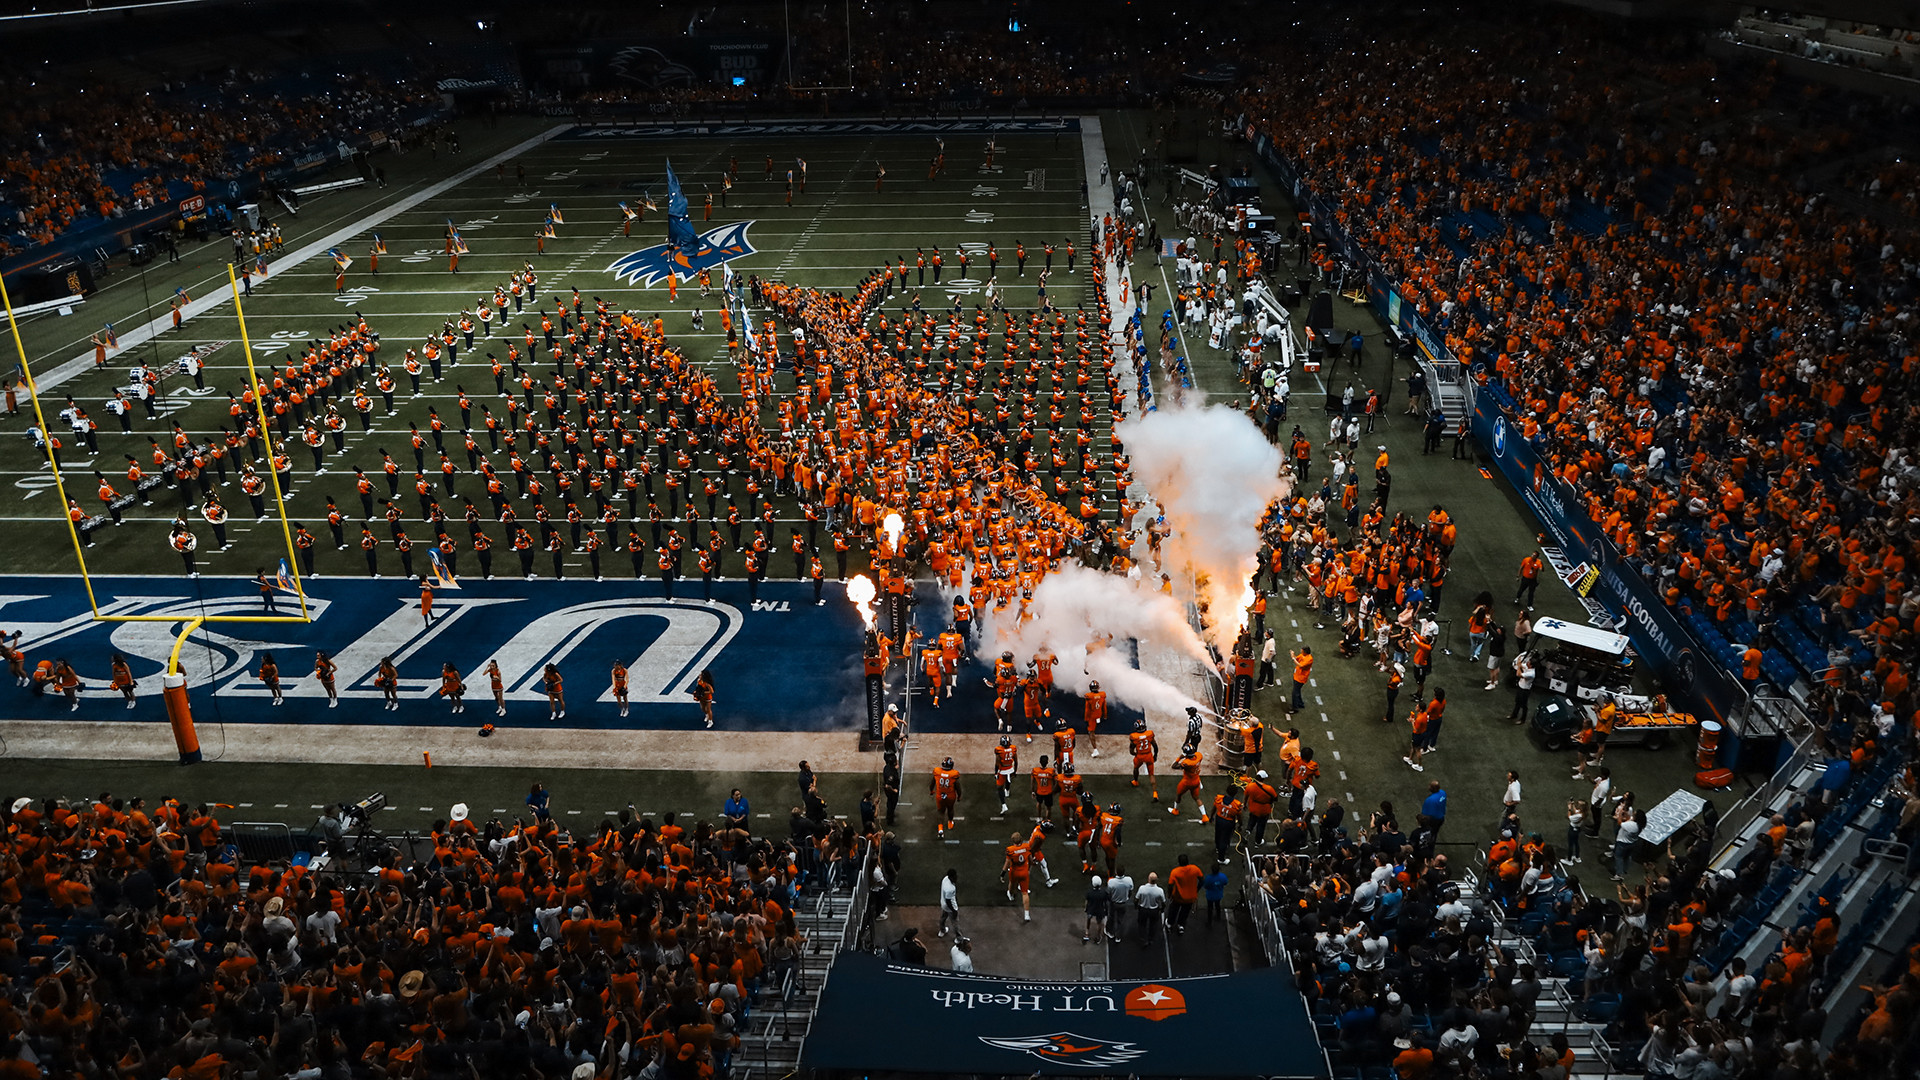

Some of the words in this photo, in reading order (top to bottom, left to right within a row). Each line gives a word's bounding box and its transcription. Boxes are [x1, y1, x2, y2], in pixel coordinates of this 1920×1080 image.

[720, 56, 758, 69] BUD
[576, 122, 1068, 137] ROADRUNNERS
[182, 198, 203, 211] H-E-B
[752, 600, 791, 612] TM
[891, 596, 900, 634] ATHLETICS
[1606, 570, 1628, 603] UTSA
[1628, 596, 1674, 660] FOOTBALL
[946, 641, 954, 650] 95
[872, 680, 880, 736] ROADRUNNERS
[1139, 740, 1149, 750] 23
[940, 778, 950, 788] 98
[1104, 824, 1112, 835] 14
[1006, 984, 1077, 992] Antonio
[930, 990, 1044, 1012] Health
[1054, 996, 1119, 1012] UT
